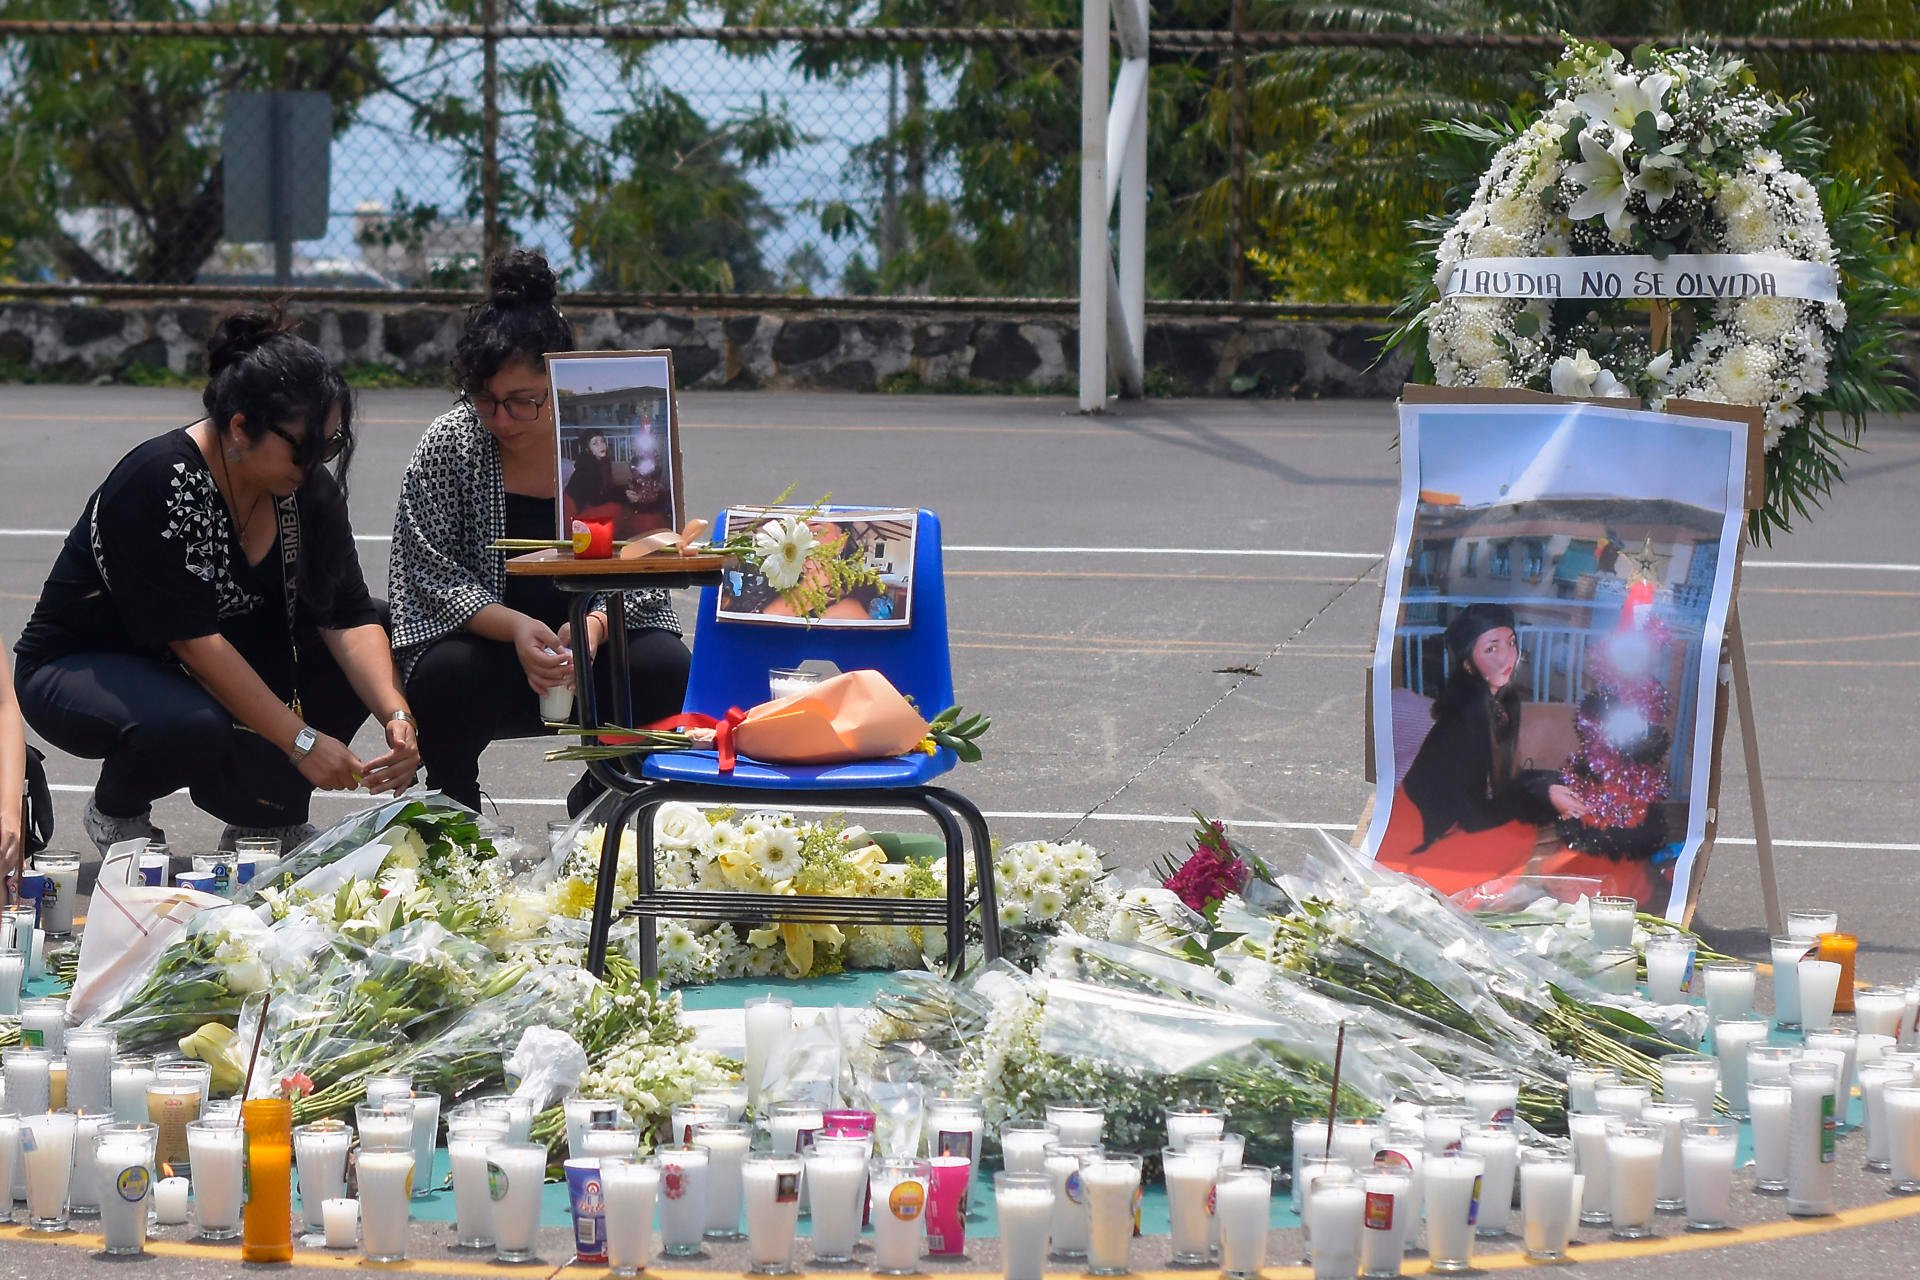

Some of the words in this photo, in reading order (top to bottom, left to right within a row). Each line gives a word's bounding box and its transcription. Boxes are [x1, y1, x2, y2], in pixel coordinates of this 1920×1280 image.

[1581, 271, 1622, 299] NO
[1633, 271, 1666, 297] SE
[1675, 272, 1777, 297] OLVIDA
[279, 496, 299, 564] BIMBA
